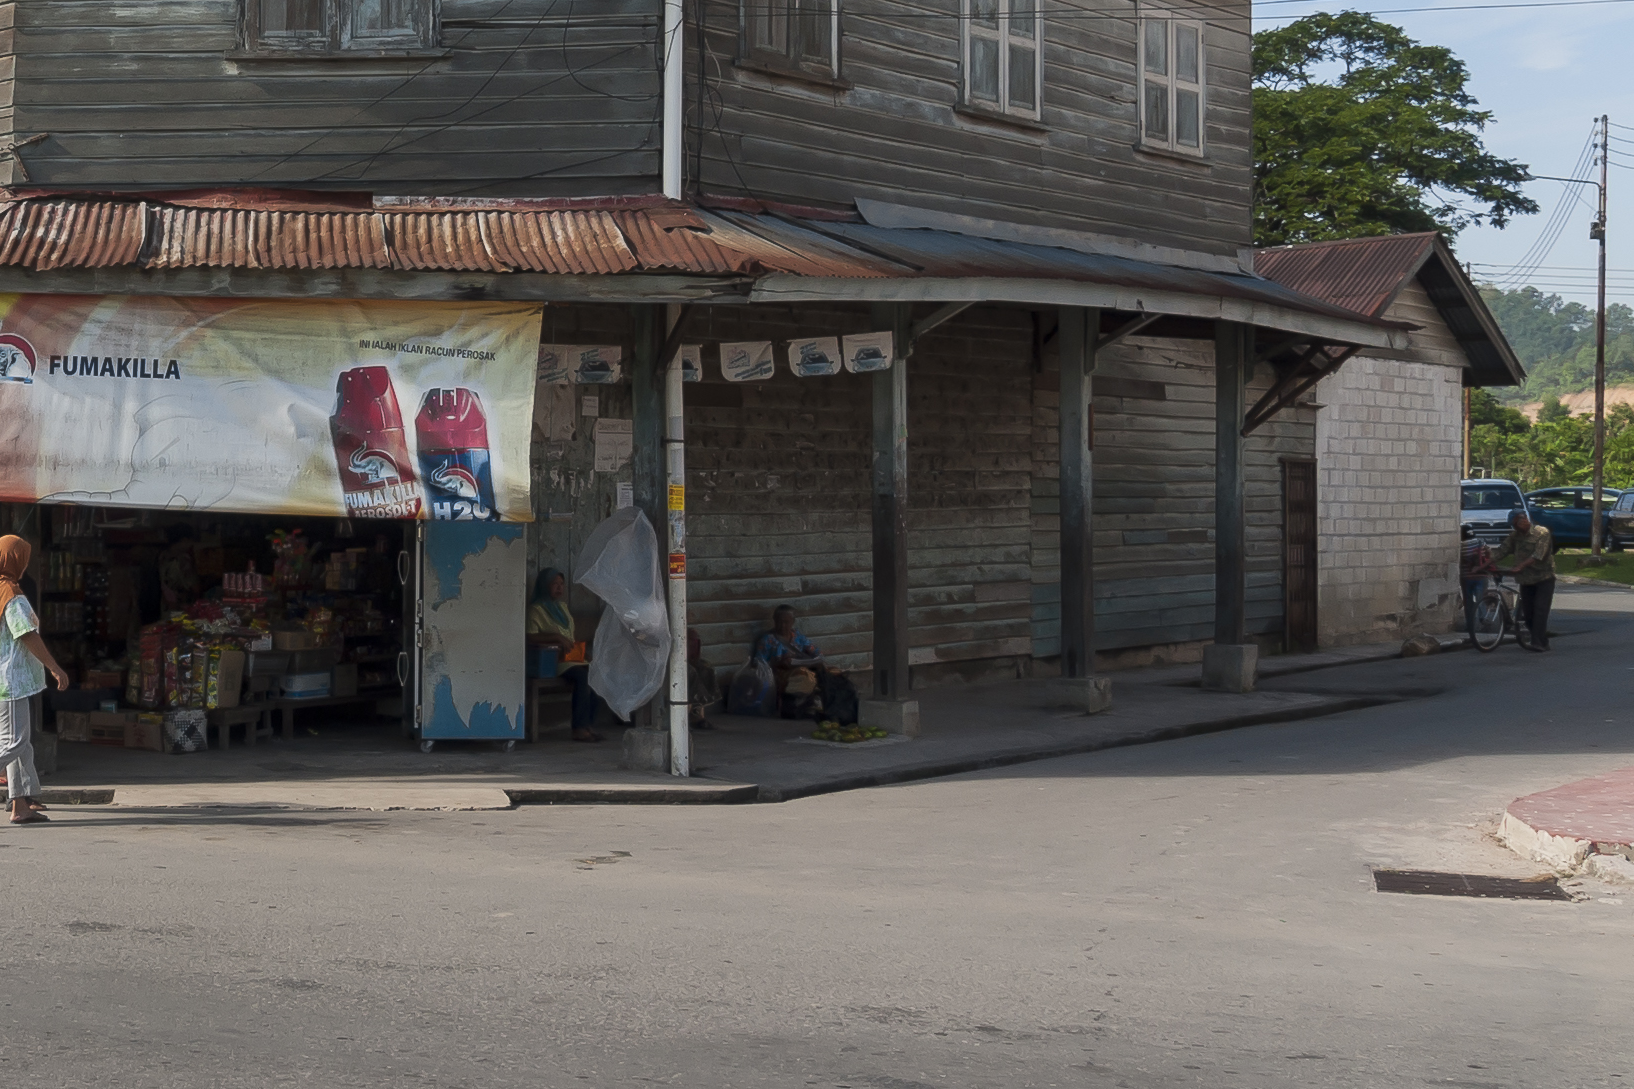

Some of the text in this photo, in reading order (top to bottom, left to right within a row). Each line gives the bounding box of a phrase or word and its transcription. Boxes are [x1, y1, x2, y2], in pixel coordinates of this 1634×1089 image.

[358, 339, 496, 361] INI IALAH IKLAN RACUN PEROSAK
[49, 355, 181, 380] FUMAKILLA
